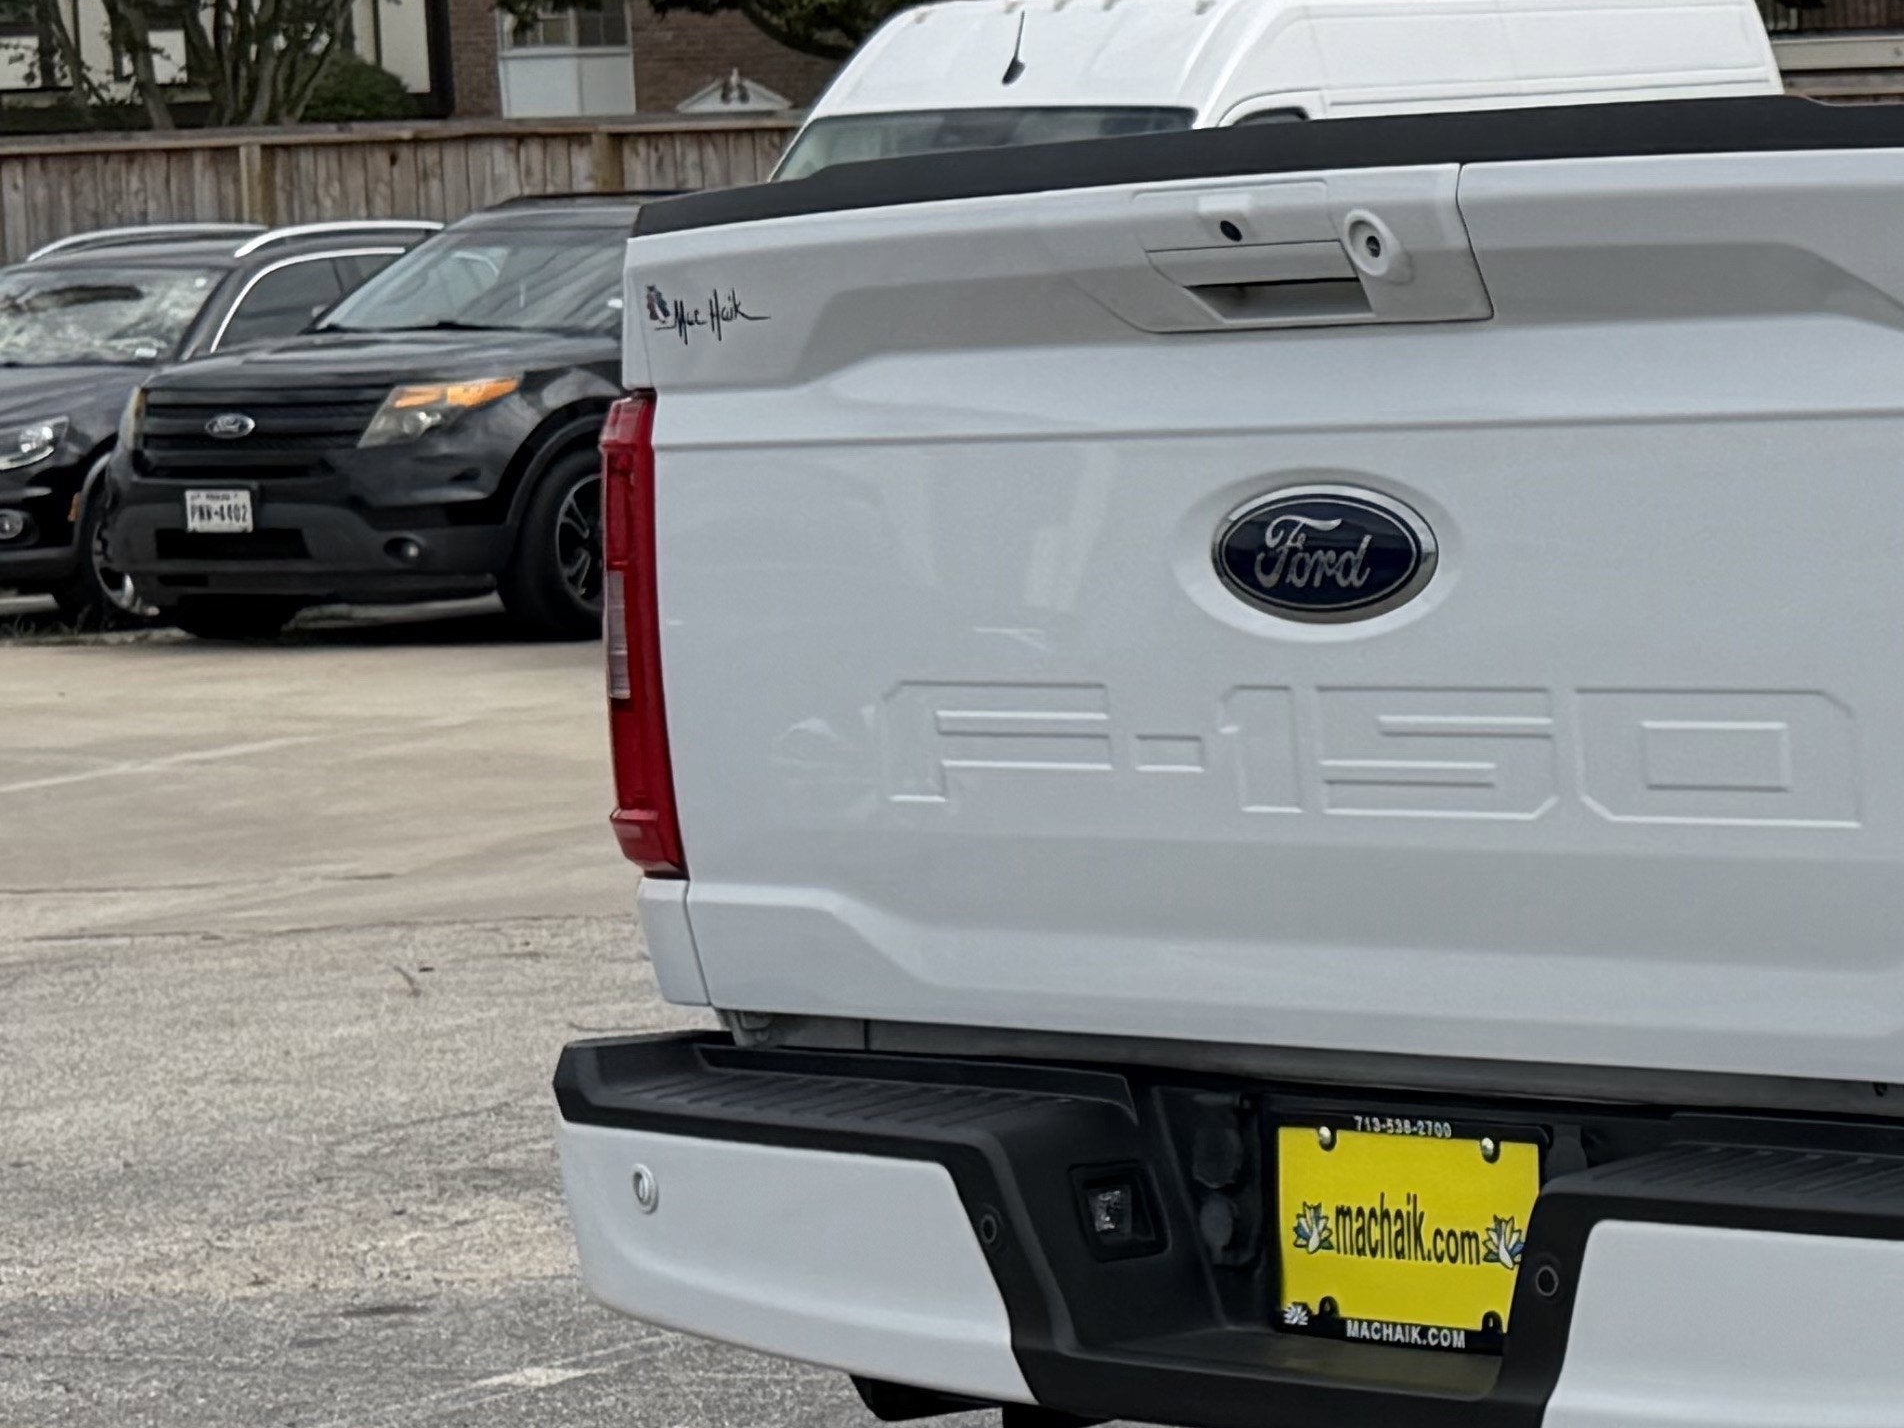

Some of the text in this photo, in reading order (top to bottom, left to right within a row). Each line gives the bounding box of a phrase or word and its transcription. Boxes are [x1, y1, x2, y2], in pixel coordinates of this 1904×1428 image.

[1254, 515, 1373, 588] Ford
[881, 681, 1862, 829] F-150
[1334, 1192, 1480, 1265] machaik.com
[1345, 1320, 1466, 1349] MACHAIK.COM
